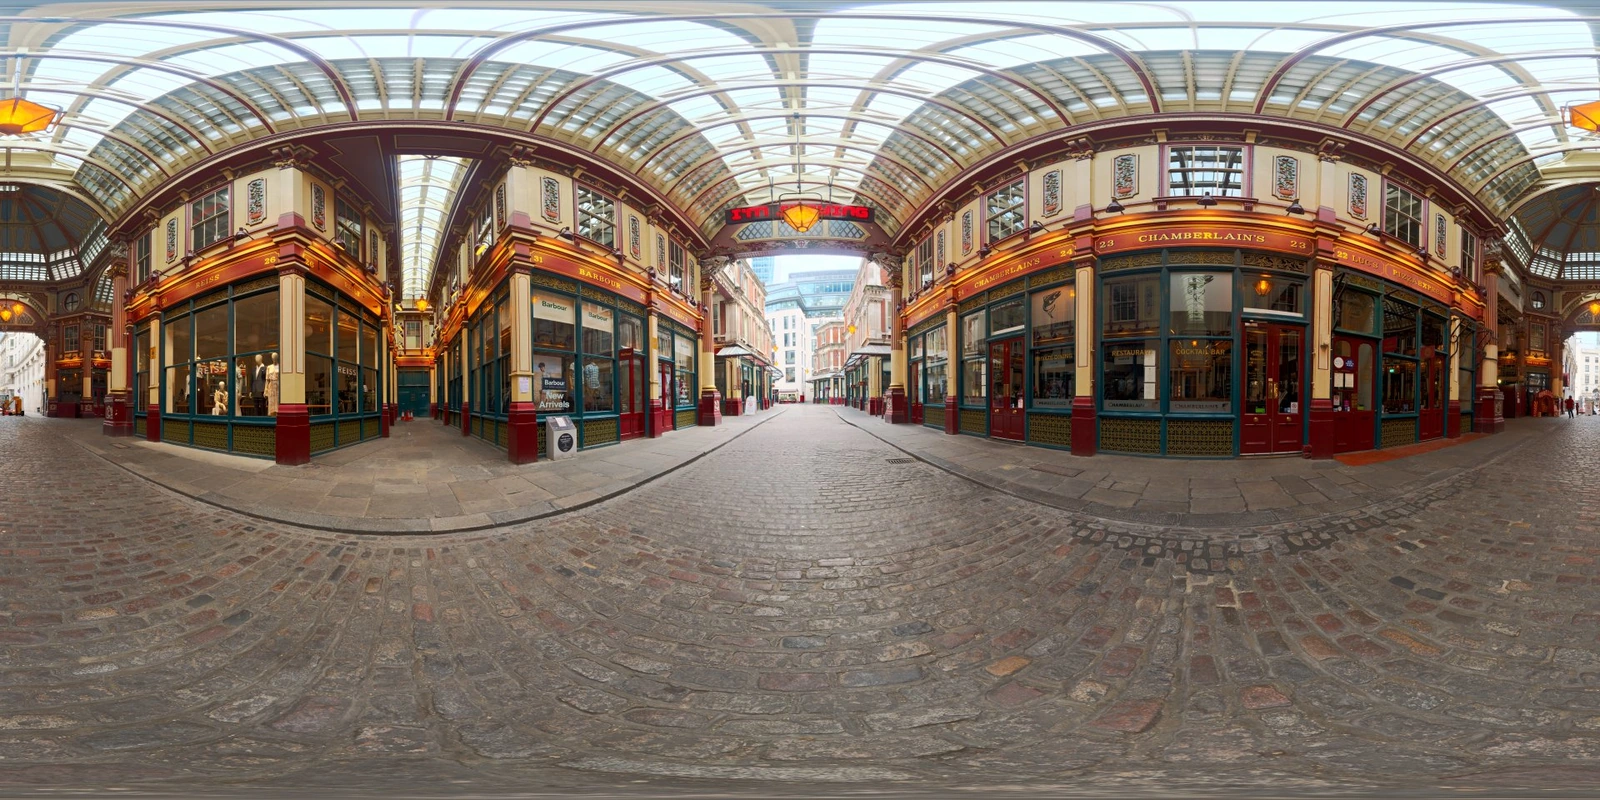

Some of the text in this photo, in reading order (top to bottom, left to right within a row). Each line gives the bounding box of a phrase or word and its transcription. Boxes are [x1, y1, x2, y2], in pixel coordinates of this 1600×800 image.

[1138, 232, 1265, 243] CHAMBERLAIN'S
[1099, 239, 1115, 249] 23
[1290, 240, 1306, 249] 23
[1060, 248, 1073, 257] 24
[1336, 250, 1348, 259] 22
[264, 256, 276, 266] 26
[533, 255, 543, 264] 31
[974, 257, 1041, 289] CHAMBERLAIN'S
[195, 273, 220, 289] REISS
[579, 267, 621, 290] BARBOUR
[541, 300, 568, 312] Barbour
[588, 311, 608, 322] Barbour
[1175, 348, 1225, 356] COCKTAIL BAR
[198, 365, 227, 375] REISS
[337, 365, 357, 376] REISS
[545, 391, 564, 400] New
[539, 400, 570, 409] Arrivals
